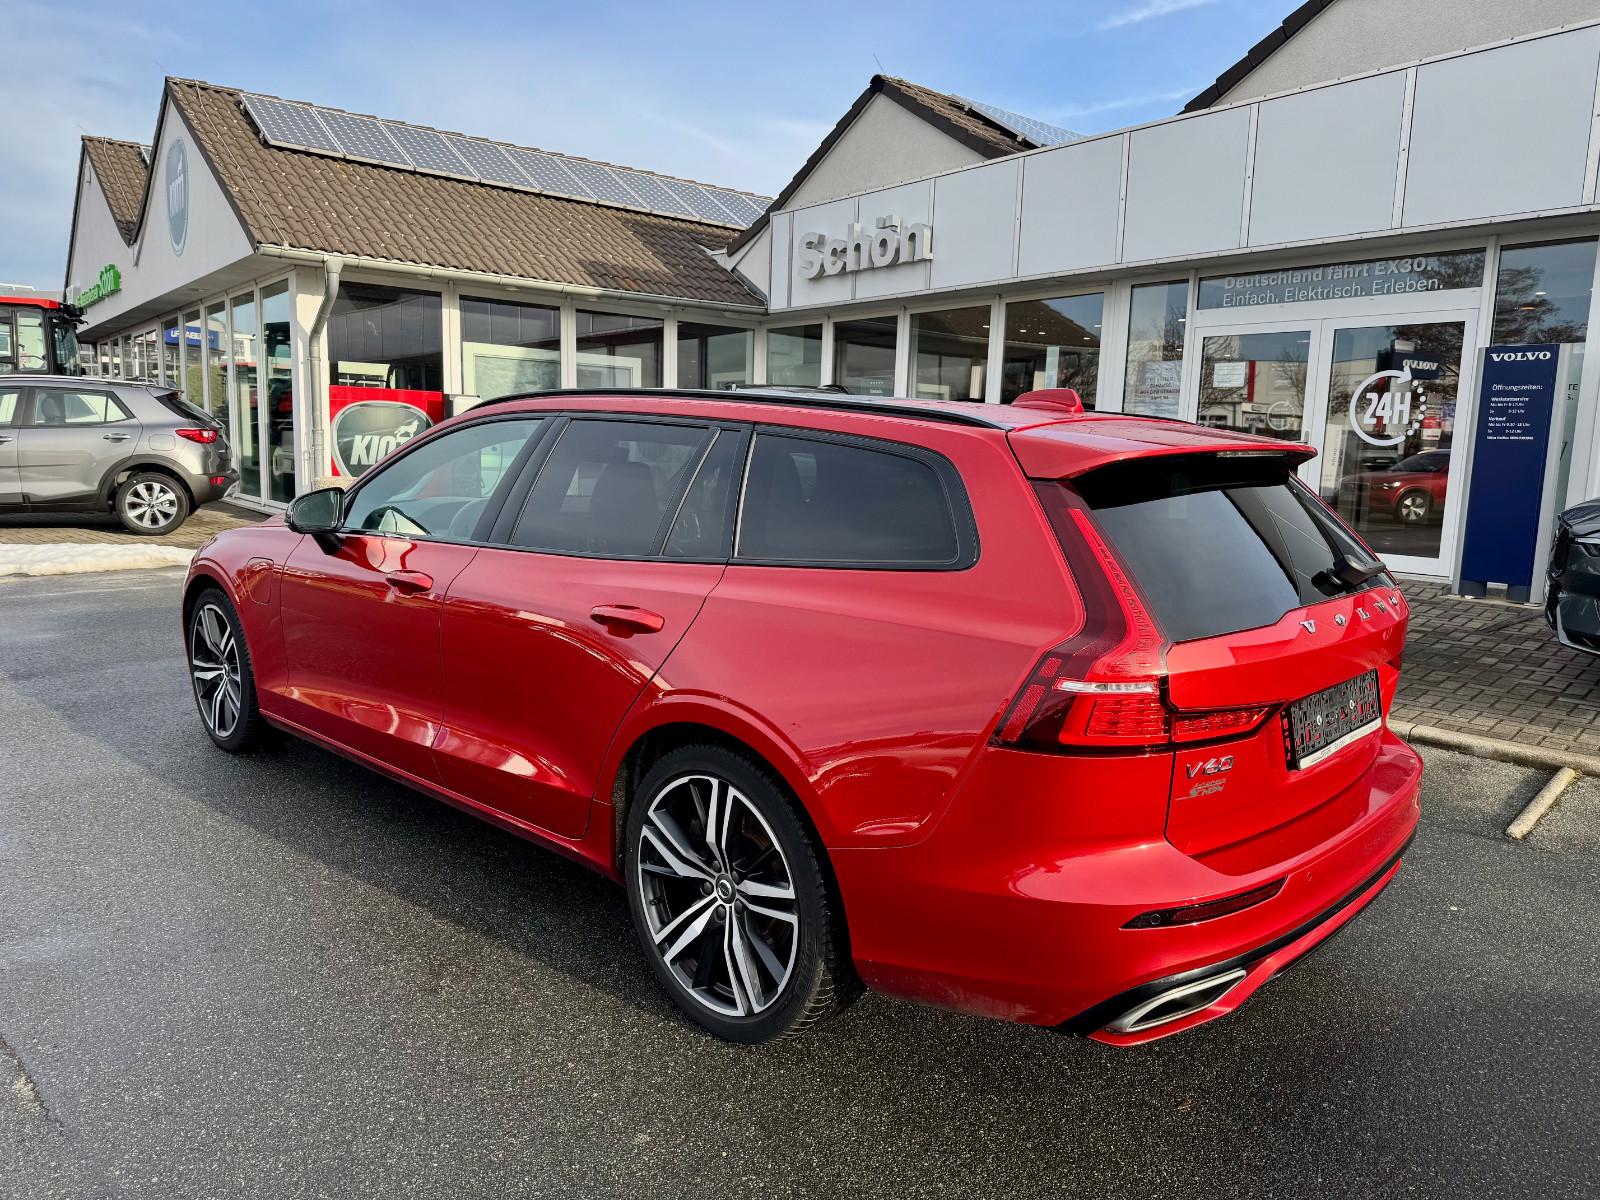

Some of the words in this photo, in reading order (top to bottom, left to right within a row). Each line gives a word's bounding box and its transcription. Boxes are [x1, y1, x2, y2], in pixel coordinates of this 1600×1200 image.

[800, 215, 933, 279] Schön
[1224, 267, 1323, 290] Deutschland
[1328, 263, 1369, 280] fährt
[1375, 256, 1432, 275] EX30.
[1223, 290, 1279, 307] Einfach.
[1284, 283, 1366, 303] Elektrisch.
[1372, 278, 1444, 294] Erleben.
[1490, 351, 1552, 362] VOLVO
[1492, 384, 1543, 392] Öffnungszeiten:
[1363, 391, 1412, 425] 24H
[350, 435, 410, 465] KIO
[1300, 596, 1398, 634] VOLVO
[1186, 756, 1234, 779] V60
